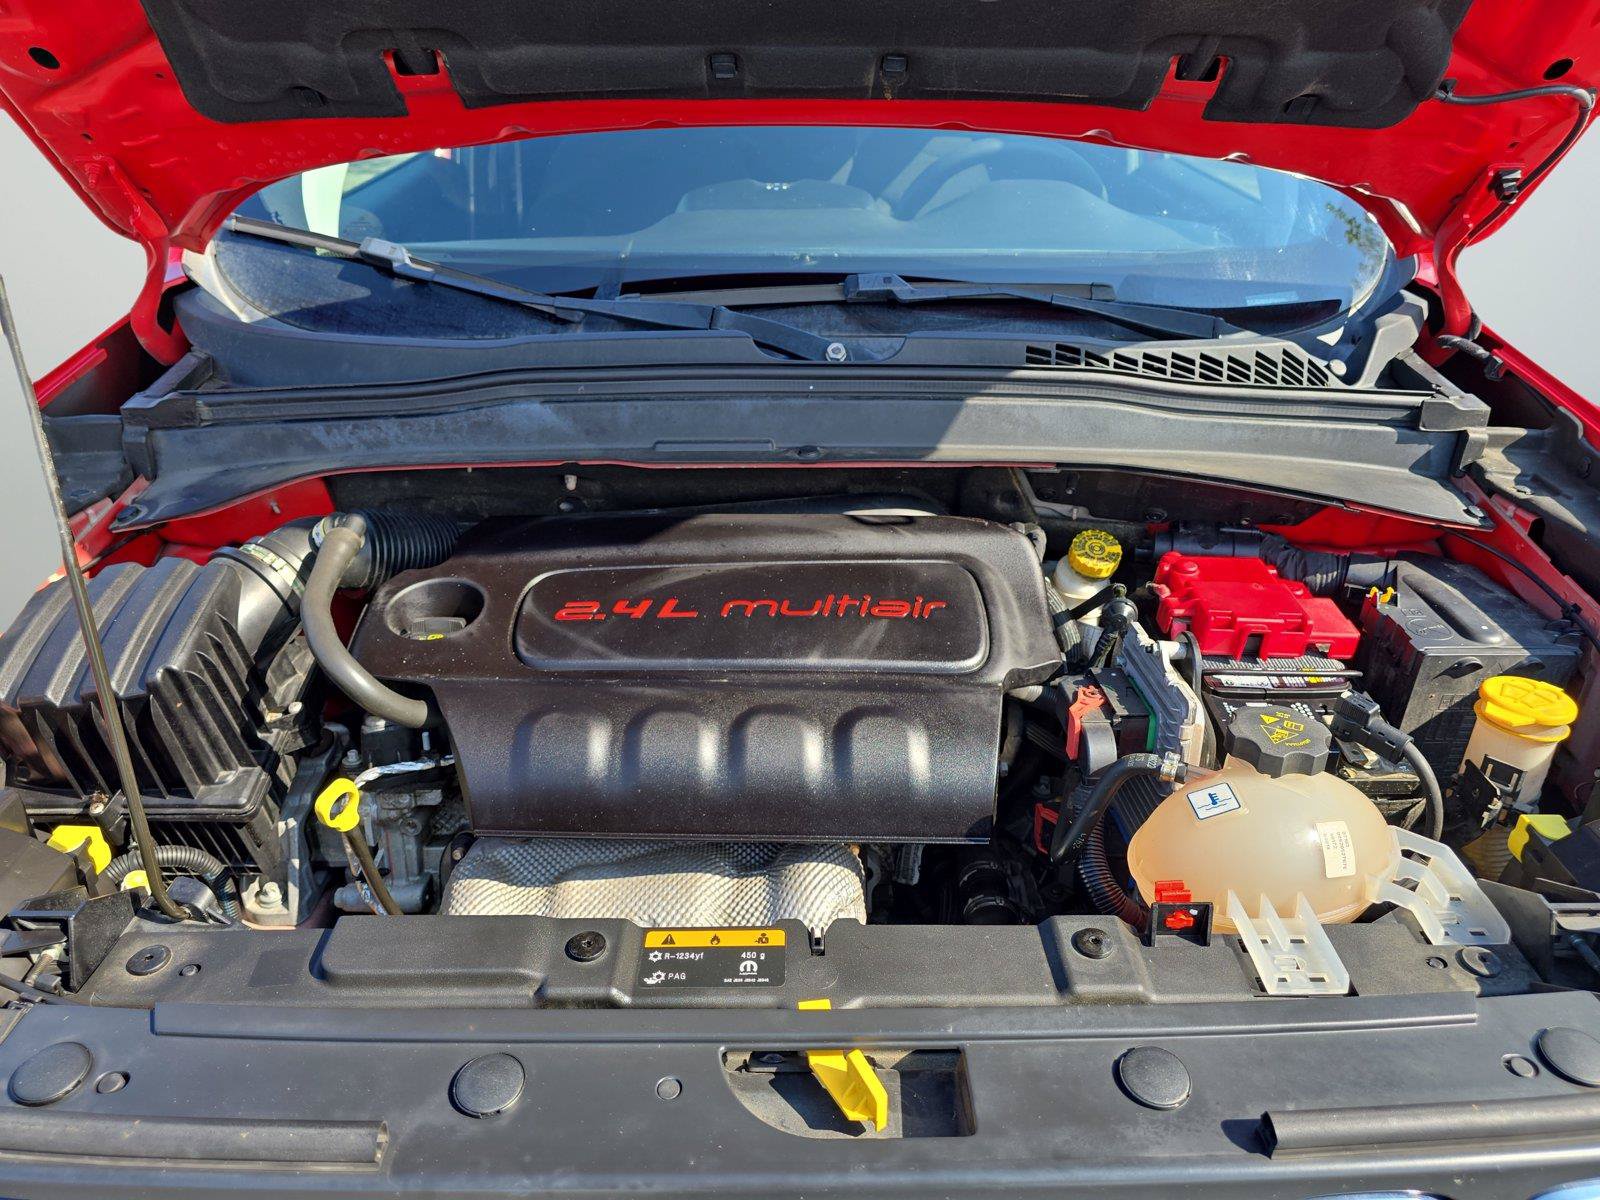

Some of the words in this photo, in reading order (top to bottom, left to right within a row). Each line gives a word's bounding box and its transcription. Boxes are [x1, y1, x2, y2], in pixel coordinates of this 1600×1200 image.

[720, 593, 947, 619] multiair
[664, 951, 704, 961] R-1234yf
[740, 951, 757, 960] 450
[759, 951, 766, 960] g
[667, 972, 686, 980] PAG
